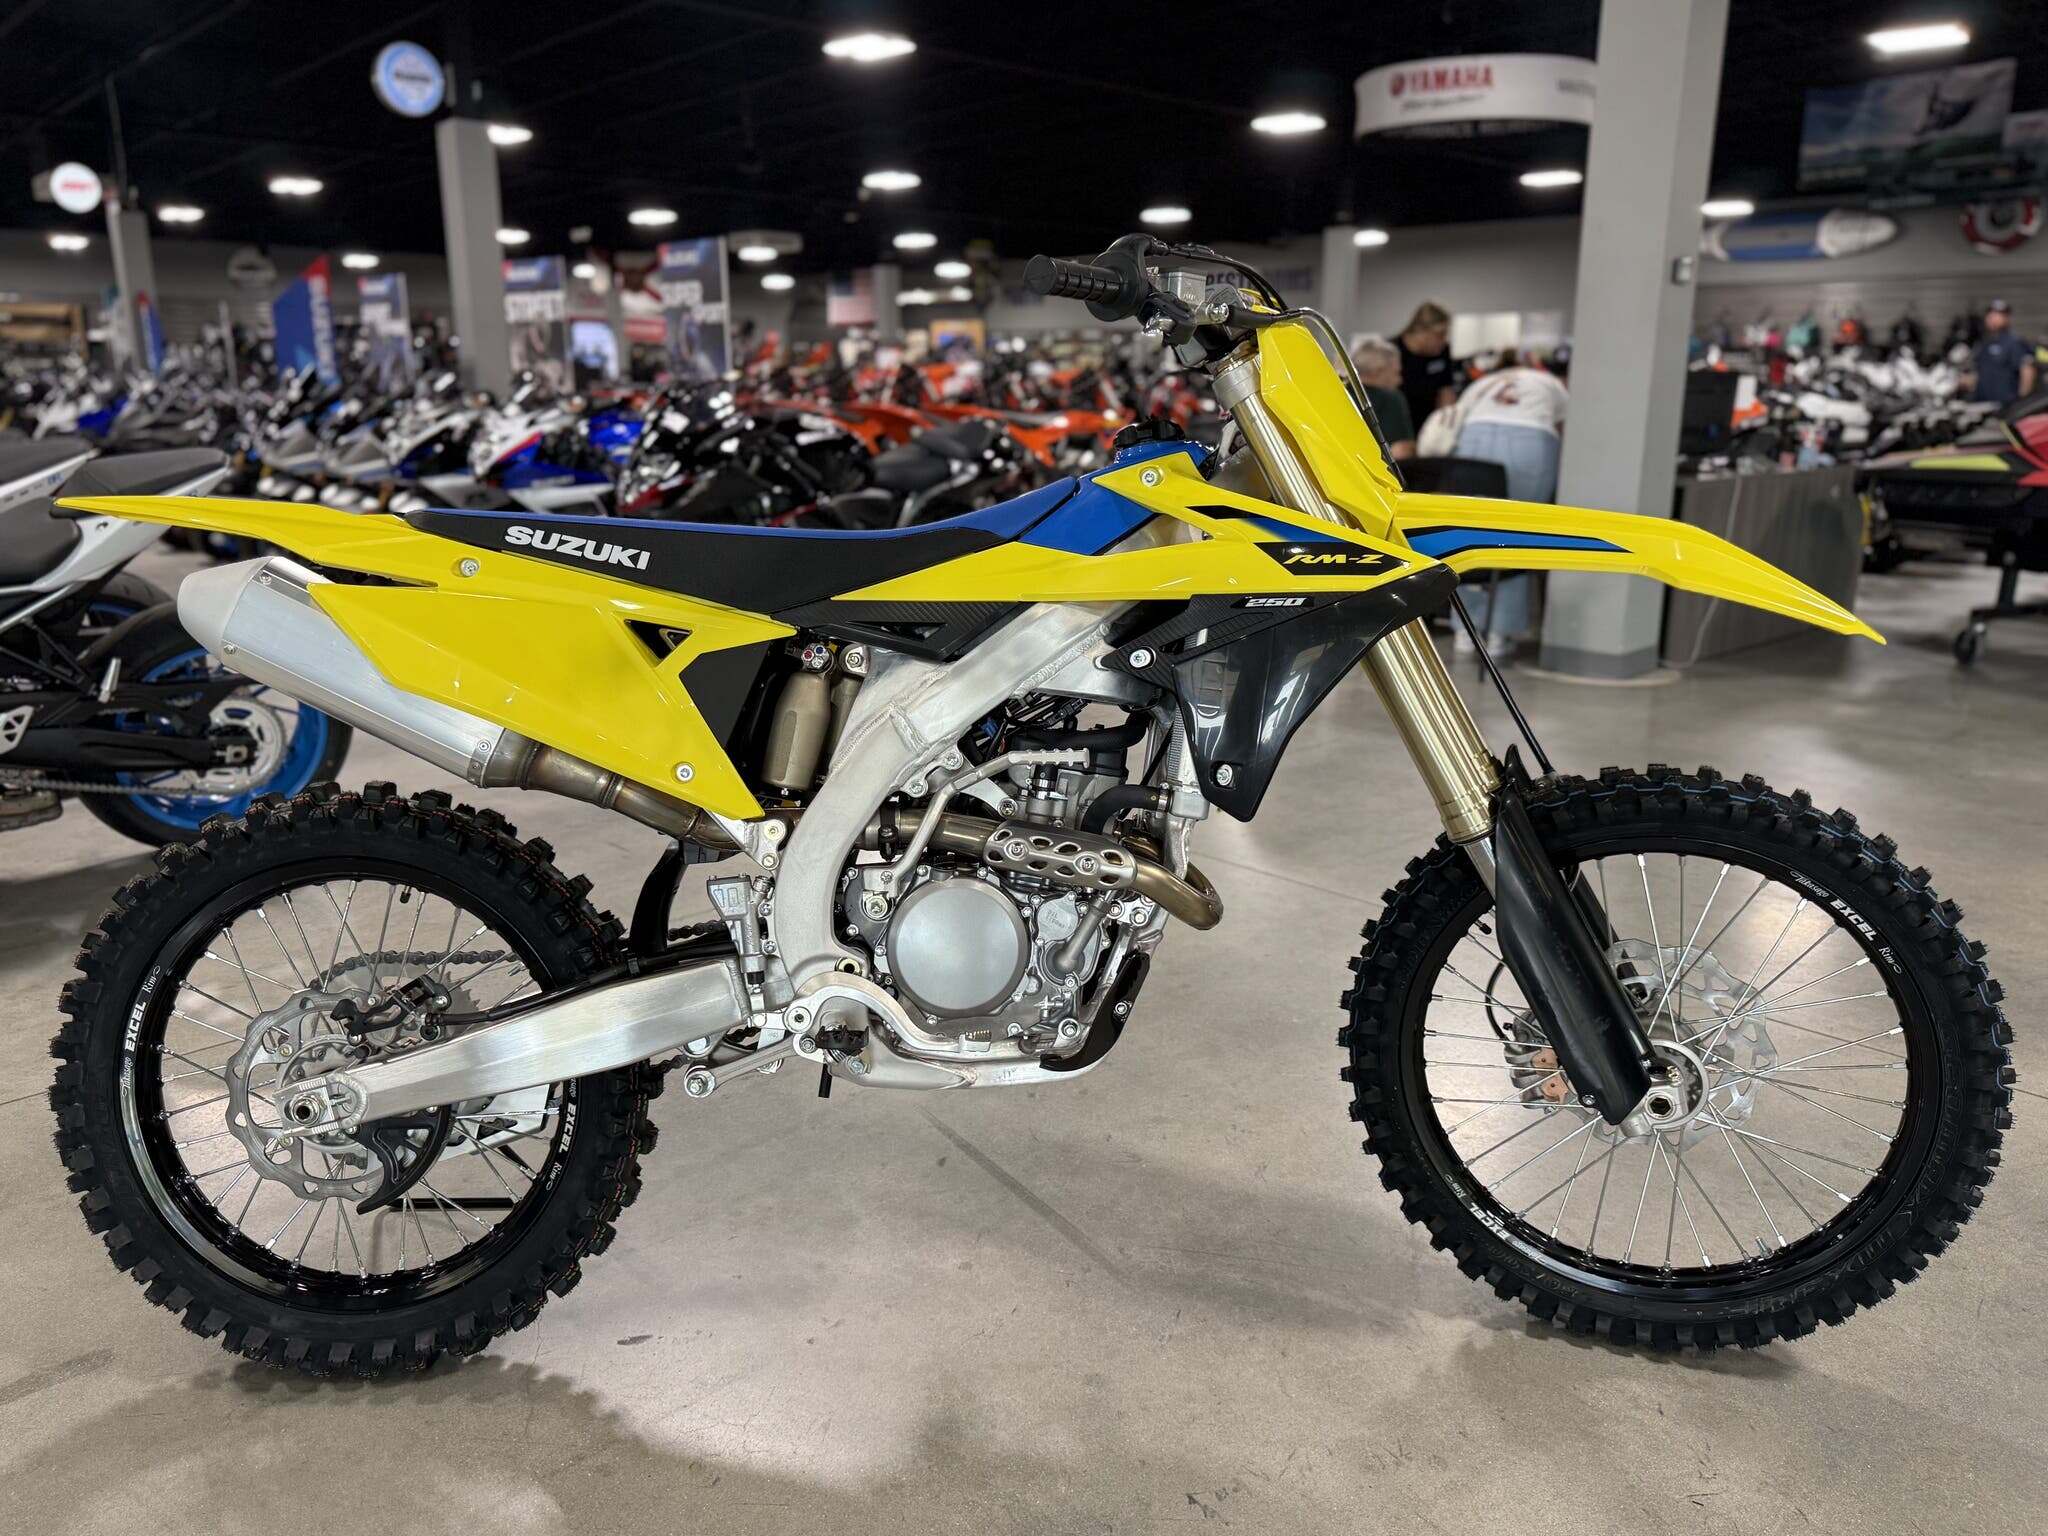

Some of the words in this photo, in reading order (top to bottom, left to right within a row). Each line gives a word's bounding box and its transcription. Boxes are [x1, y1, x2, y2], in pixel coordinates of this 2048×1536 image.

[504, 525, 651, 570] SUZUKI
[1283, 554, 1385, 565] RM-Z
[1244, 597, 1306, 608] 250
[1830, 899, 1879, 942] EXCEL
[124, 1001, 146, 1052] EXCEL
[559, 1102, 577, 1153] EXCEL
[1470, 1202, 1511, 1240] EXCEL
